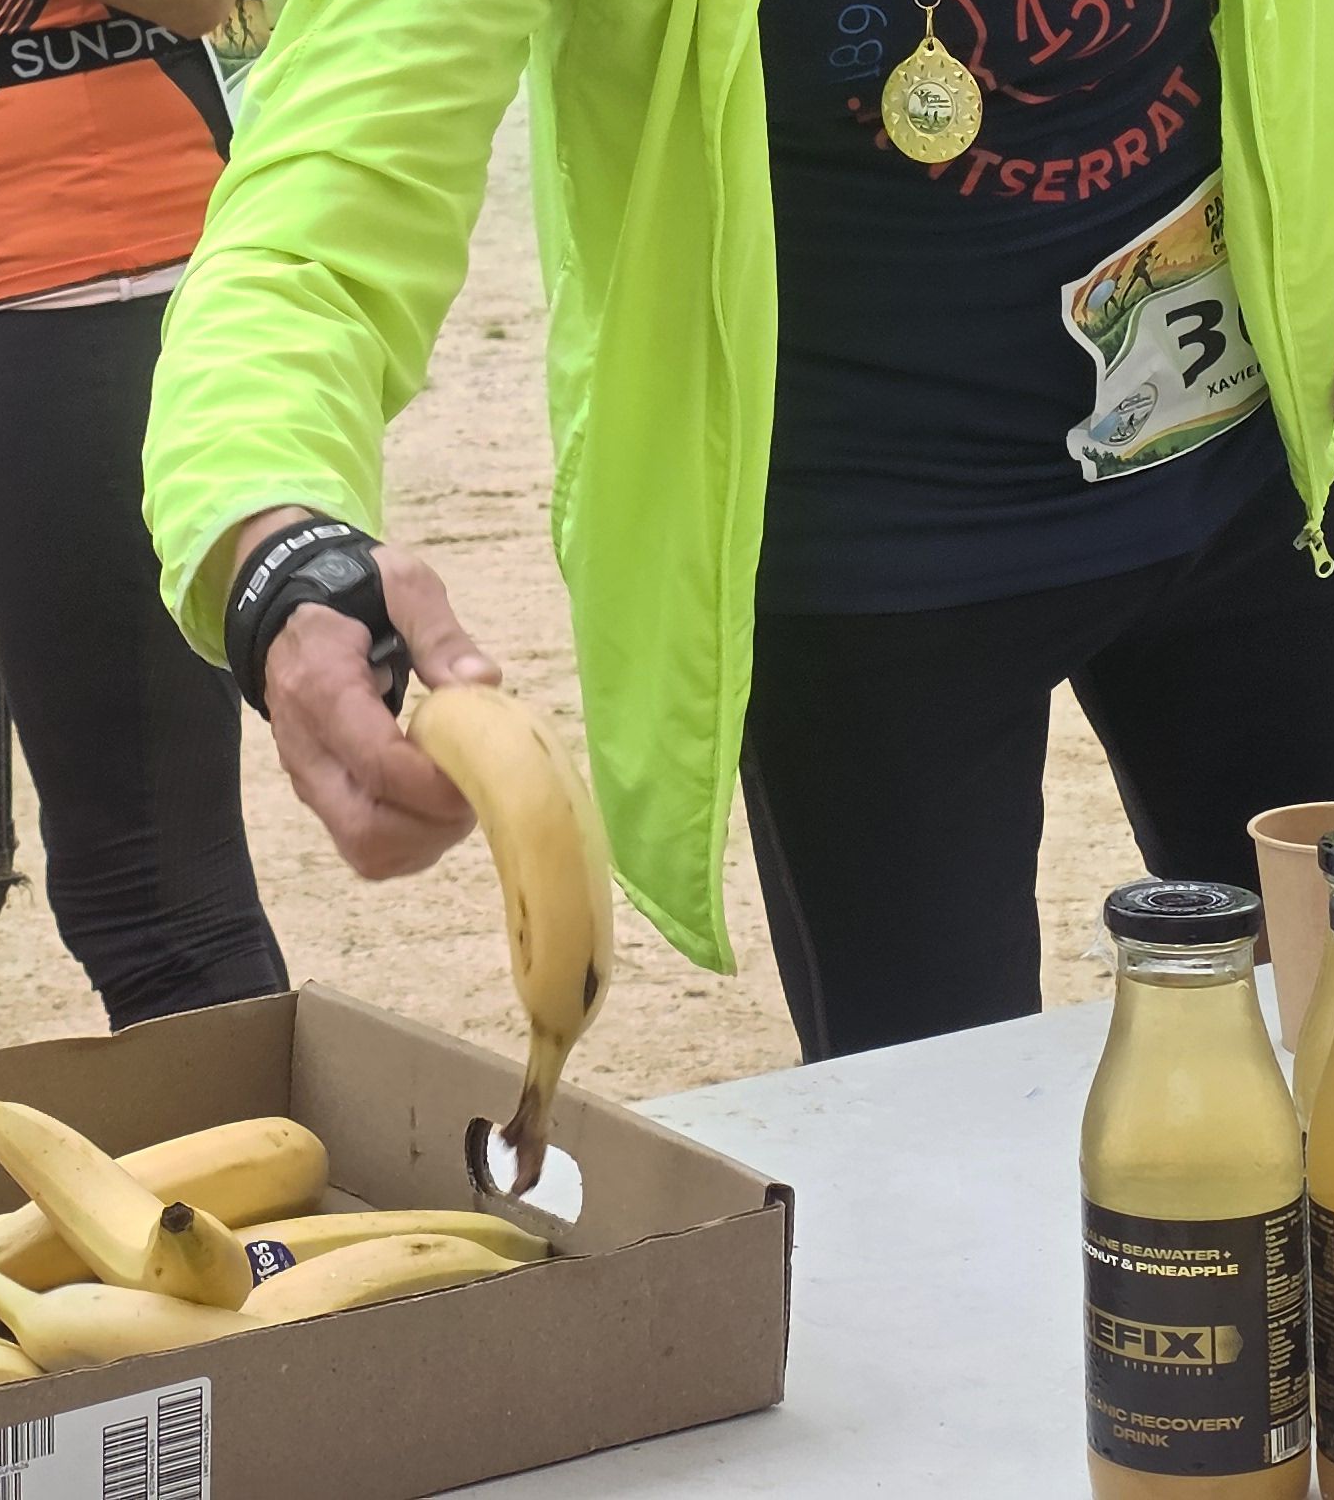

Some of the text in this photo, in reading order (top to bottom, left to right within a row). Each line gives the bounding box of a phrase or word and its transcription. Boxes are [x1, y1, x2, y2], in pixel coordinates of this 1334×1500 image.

[1122, 1243, 1220, 1262] SEAWATER
[1121, 1258, 1133, 1271] &
[1136, 1261, 1239, 1278] PINEAPPLE
[1087, 1305, 1205, 1360] EFIX
[1131, 1412, 1245, 1432] RECOVERY
[1113, 1424, 1170, 1447] DRINK
